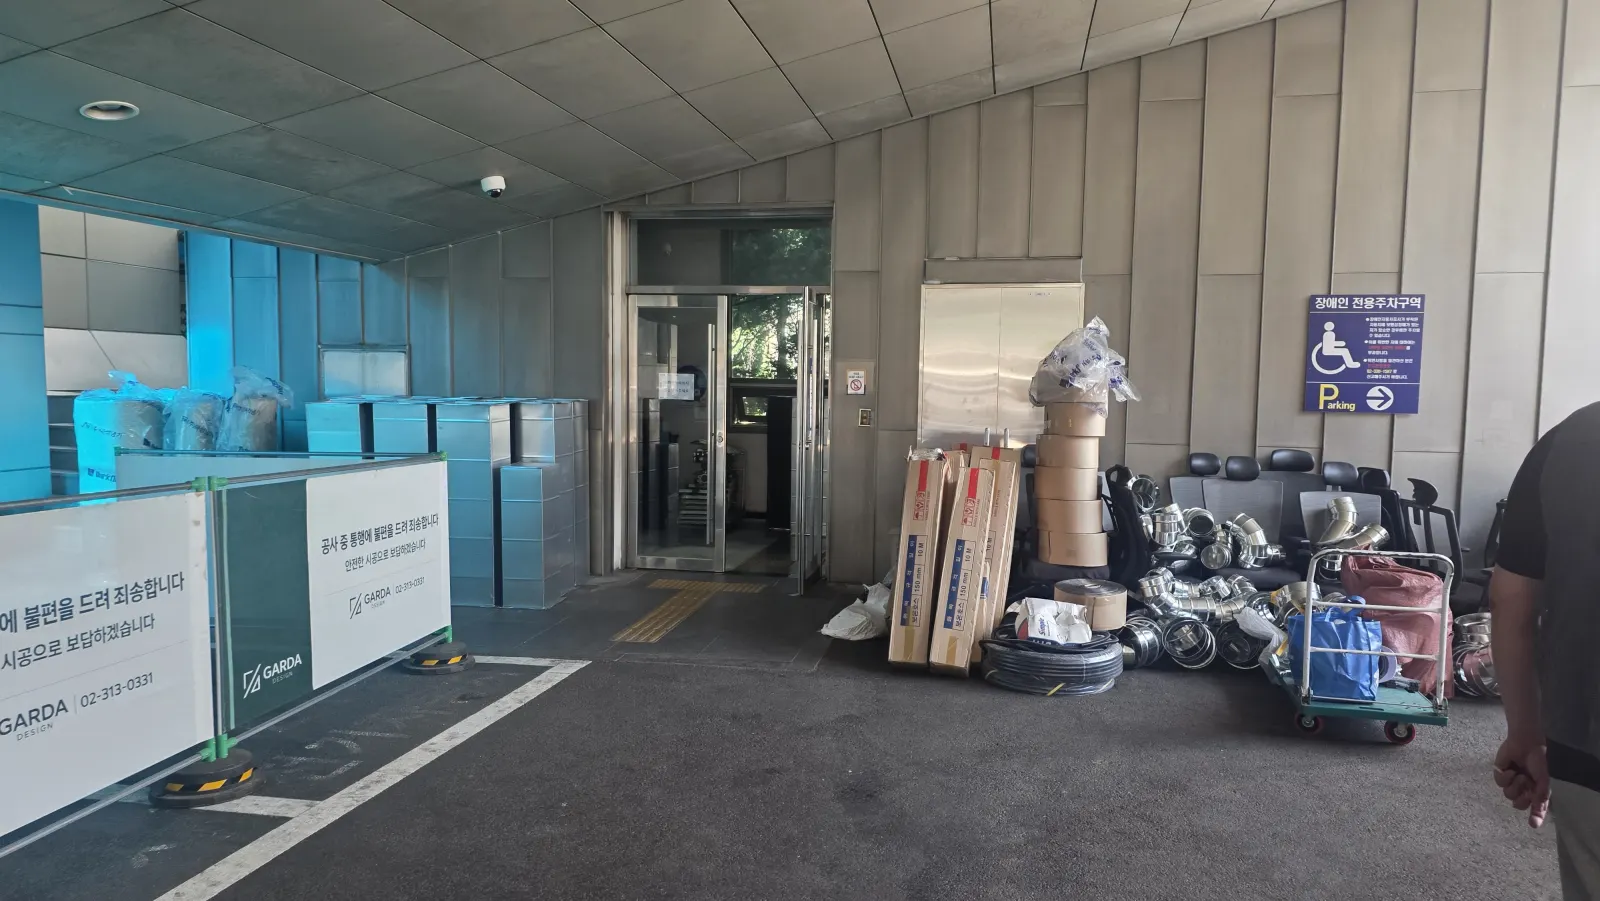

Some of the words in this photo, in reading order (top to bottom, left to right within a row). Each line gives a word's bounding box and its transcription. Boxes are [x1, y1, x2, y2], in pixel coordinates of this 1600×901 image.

[1315, 297, 1349, 309] 장애인
[1352, 297, 1421, 309] 전용주차구역
[1319, 384, 1355, 411] Parking
[321, 537, 338, 555] 공사
[340, 535, 349, 550] 중
[350, 530, 373, 549] 통행에
[374, 524, 394, 542] 불편을
[395, 520, 408, 536] 드려
[408, 512, 439, 533] 죄송합니다
[345, 554, 364, 572] 안전한
[365, 550, 389, 566] 시공으로
[390, 540, 426, 560] 보답하겠습니다
[916, 567, 922, 579] mm
[962, 572, 969, 584] mm
[0, 609, 18, 634] 에
[23, 597, 75, 630] 불편을
[79, 588, 111, 615] 드려
[114, 571, 185, 606] 죄송합니다
[364, 586, 391, 605] GARDA
[395, 576, 425, 594] 02-313-0331
[1, 640, 62, 671] 시공으로
[66, 613, 156, 653] 보답하겠습니다
[263, 653, 302, 680] GARDA
[0, 699, 69, 736] GARDA
[80, 672, 154, 708] 02-313-0331
[16, 723, 54, 741] DESIGN
